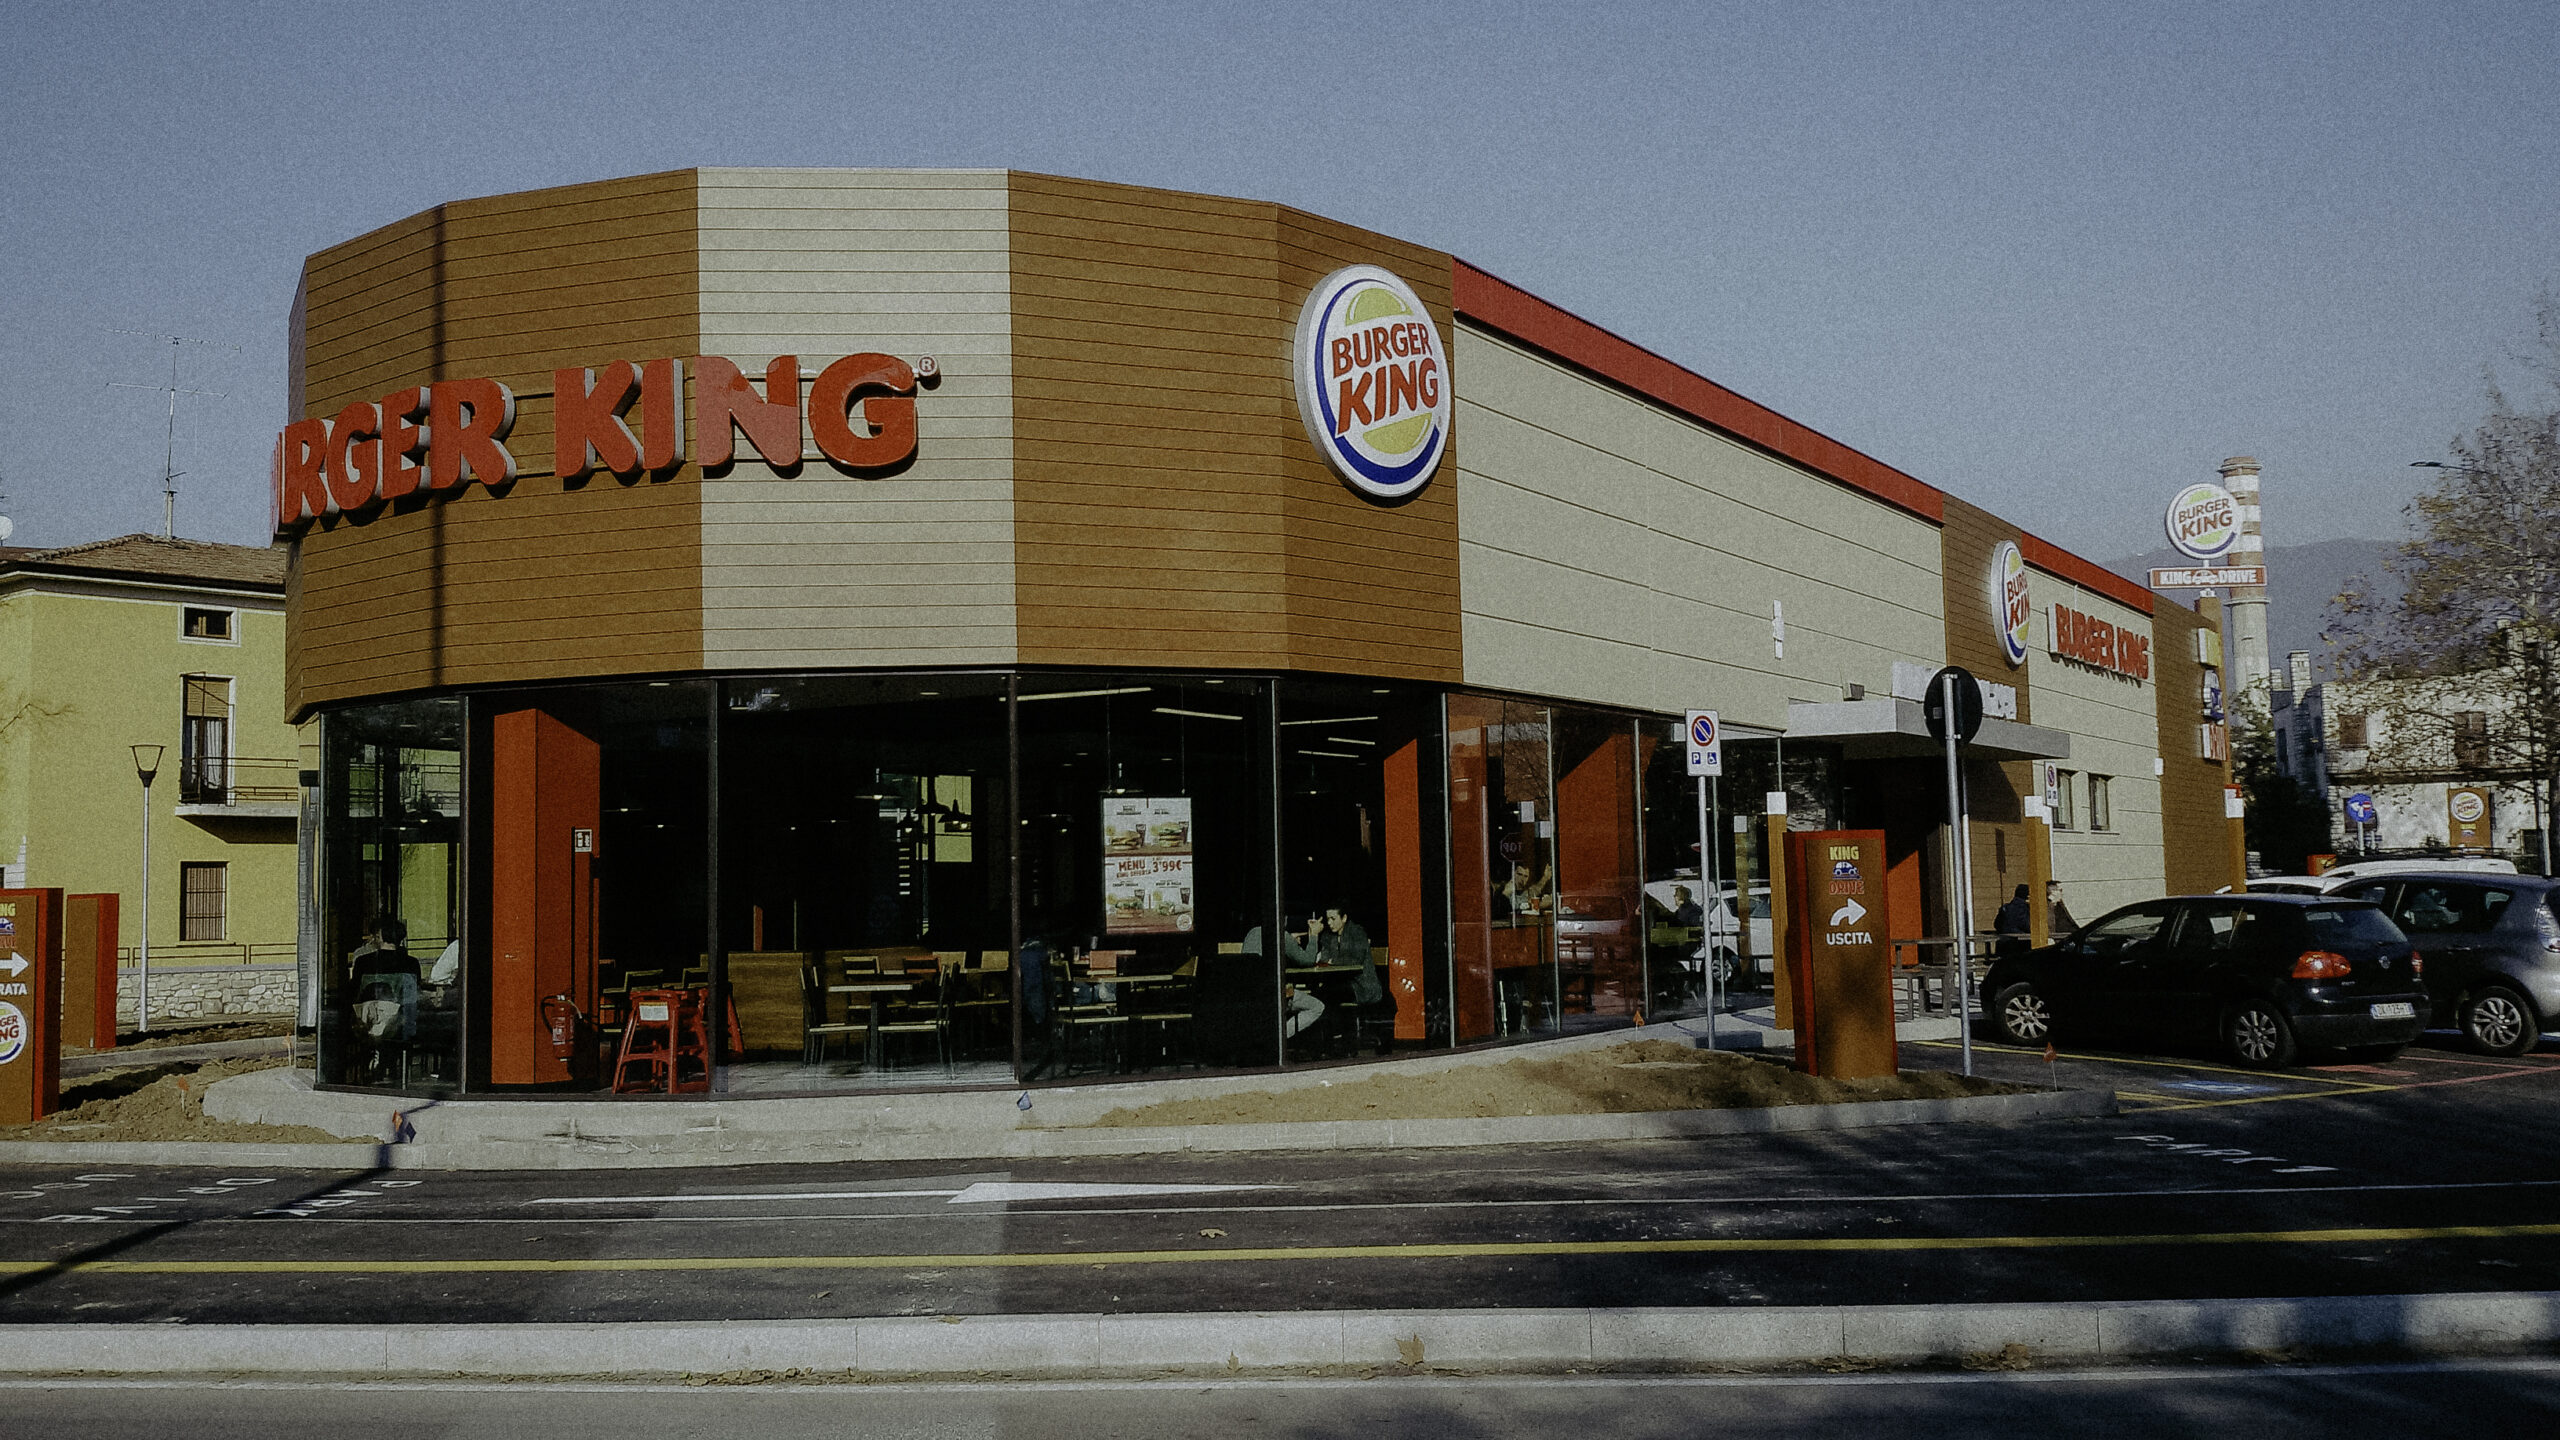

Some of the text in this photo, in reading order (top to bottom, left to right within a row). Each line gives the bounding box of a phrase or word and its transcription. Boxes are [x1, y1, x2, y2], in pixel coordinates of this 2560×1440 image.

[1332, 322, 1433, 379] BURGER
[1338, 358, 1439, 435] KING
[271, 377, 514, 524] RGER
[2178, 498, 2231, 523] BURGER
[2181, 510, 2233, 541] KING
[2160, 569, 2257, 585] KING DRIVE
[1829, 846, 1860, 860] KING
[1118, 860, 1146, 872] MENU
[1829, 881, 1865, 895] DRIVE
[1826, 932, 1873, 946] USCITA
